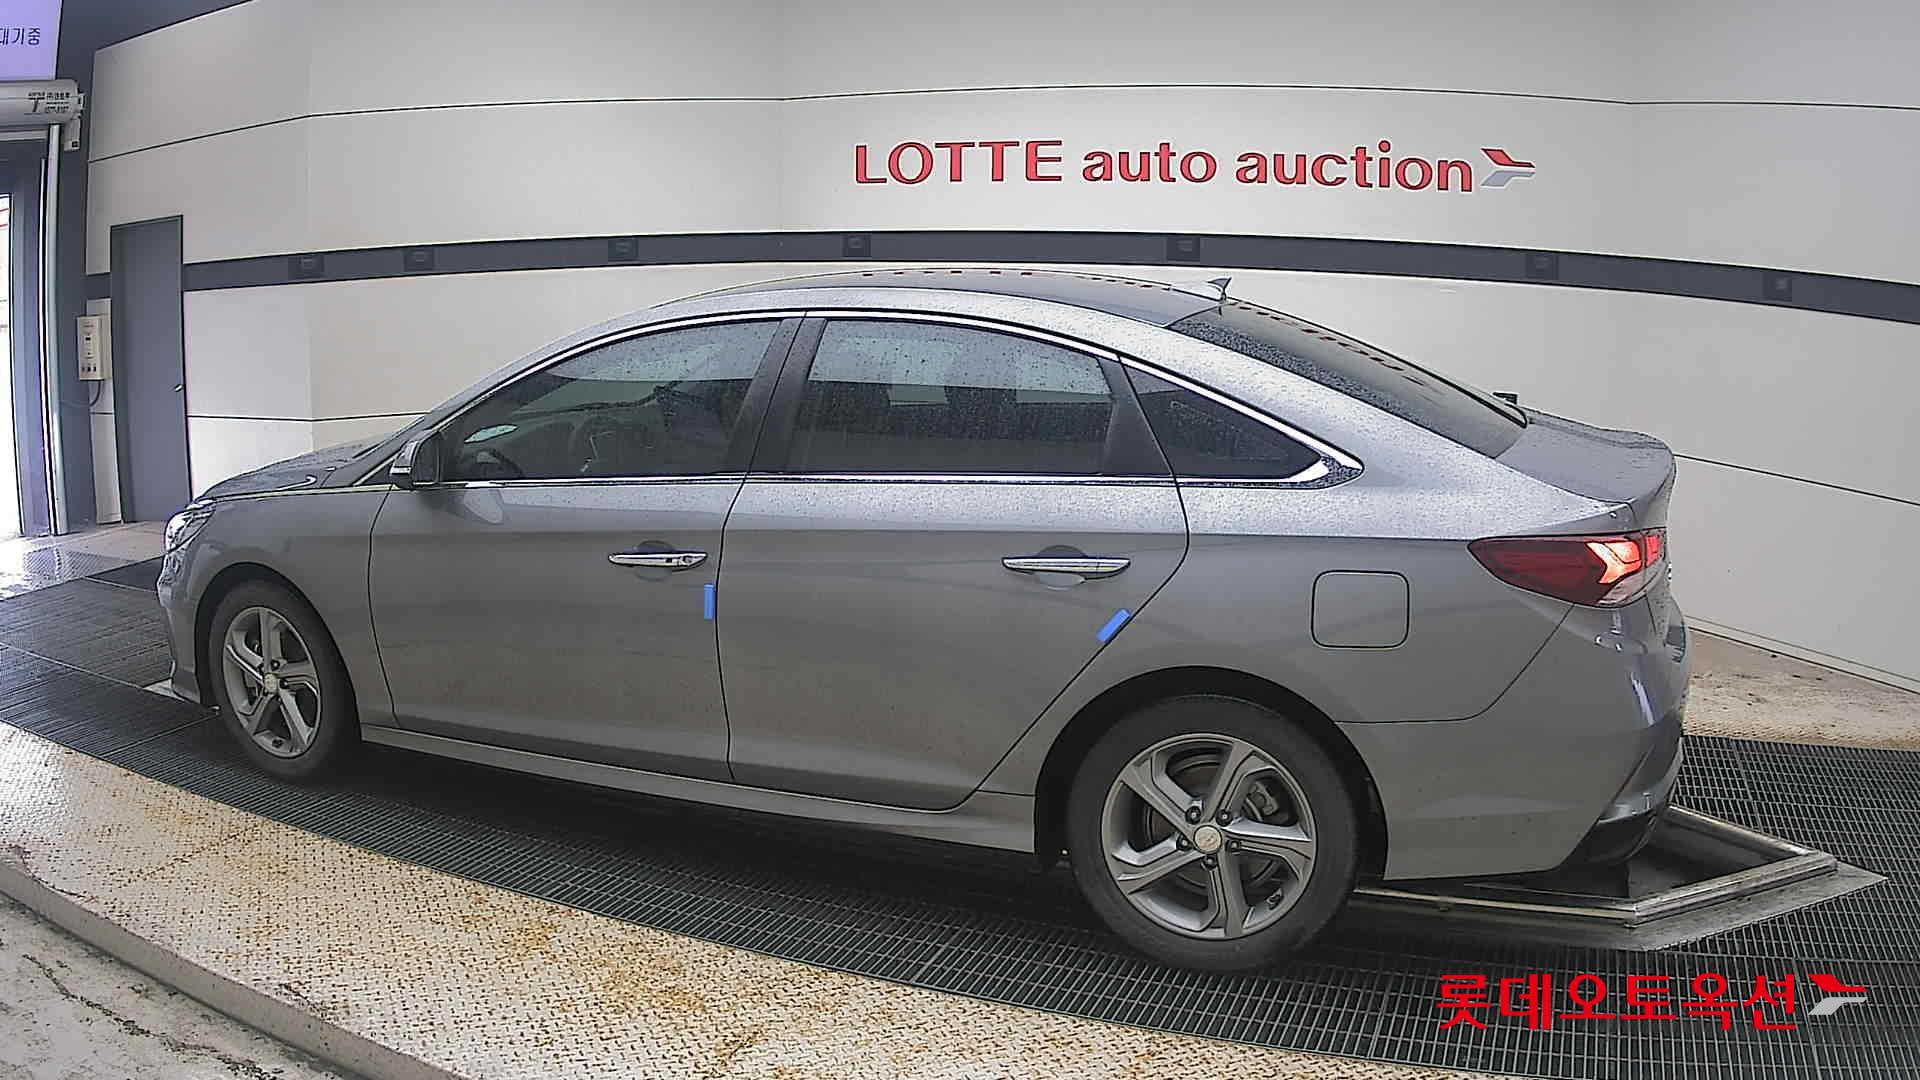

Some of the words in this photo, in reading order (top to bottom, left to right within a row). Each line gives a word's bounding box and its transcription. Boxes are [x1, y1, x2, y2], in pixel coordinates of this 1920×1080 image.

[855, 140, 1062, 185] LOTTE
[1083, 142, 1217, 184] auto
[1235, 140, 1473, 193] auction
